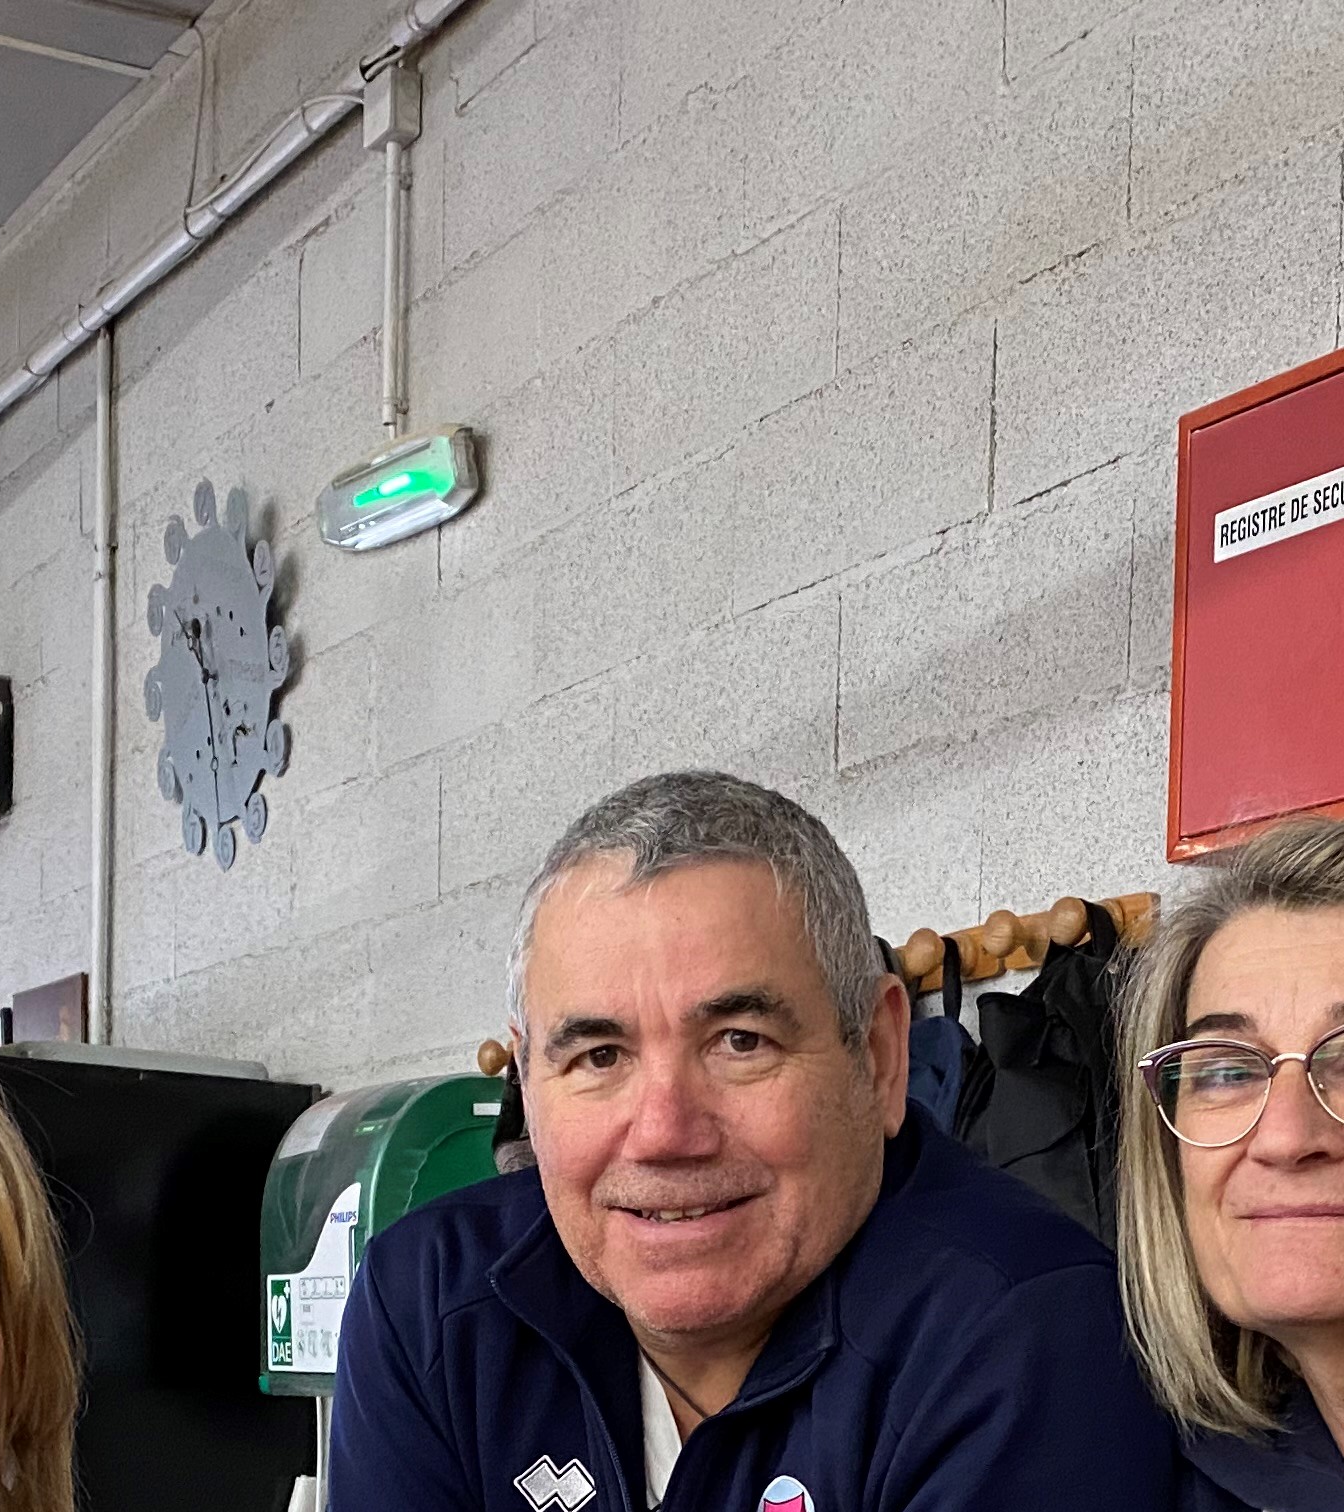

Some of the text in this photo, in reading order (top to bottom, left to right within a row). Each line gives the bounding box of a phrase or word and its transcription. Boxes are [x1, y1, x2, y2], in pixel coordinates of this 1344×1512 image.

[1220, 502, 1286, 548] REGISTRE
[1291, 494, 1308, 523] DE
[330, 1210, 357, 1224] PHILIPS
[272, 1341, 292, 1363] DAE
